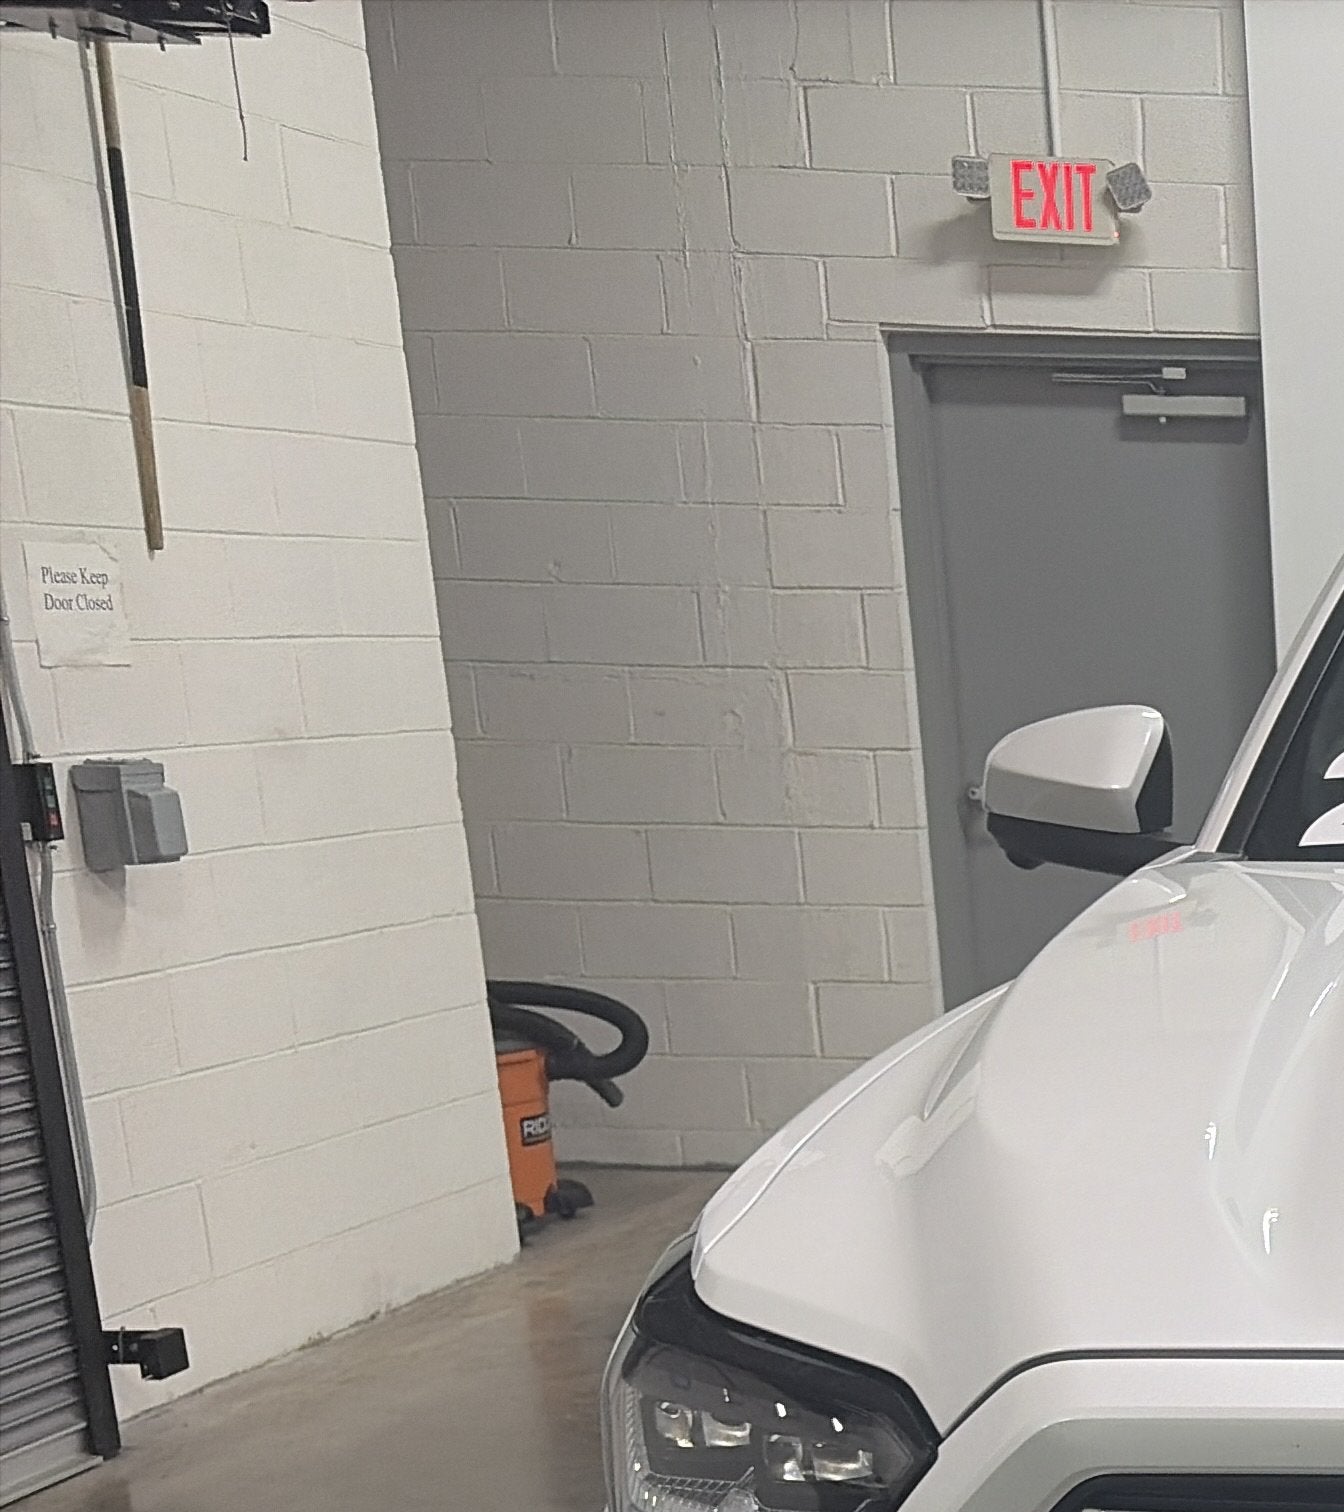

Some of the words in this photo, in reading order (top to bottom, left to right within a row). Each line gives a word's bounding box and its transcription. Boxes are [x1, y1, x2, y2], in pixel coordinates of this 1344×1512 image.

[1010, 159, 1097, 233] EXIT
[41, 566, 77, 584] Please
[79, 567, 109, 589] Keep
[44, 592, 74, 611] Door
[75, 593, 114, 612] Closed
